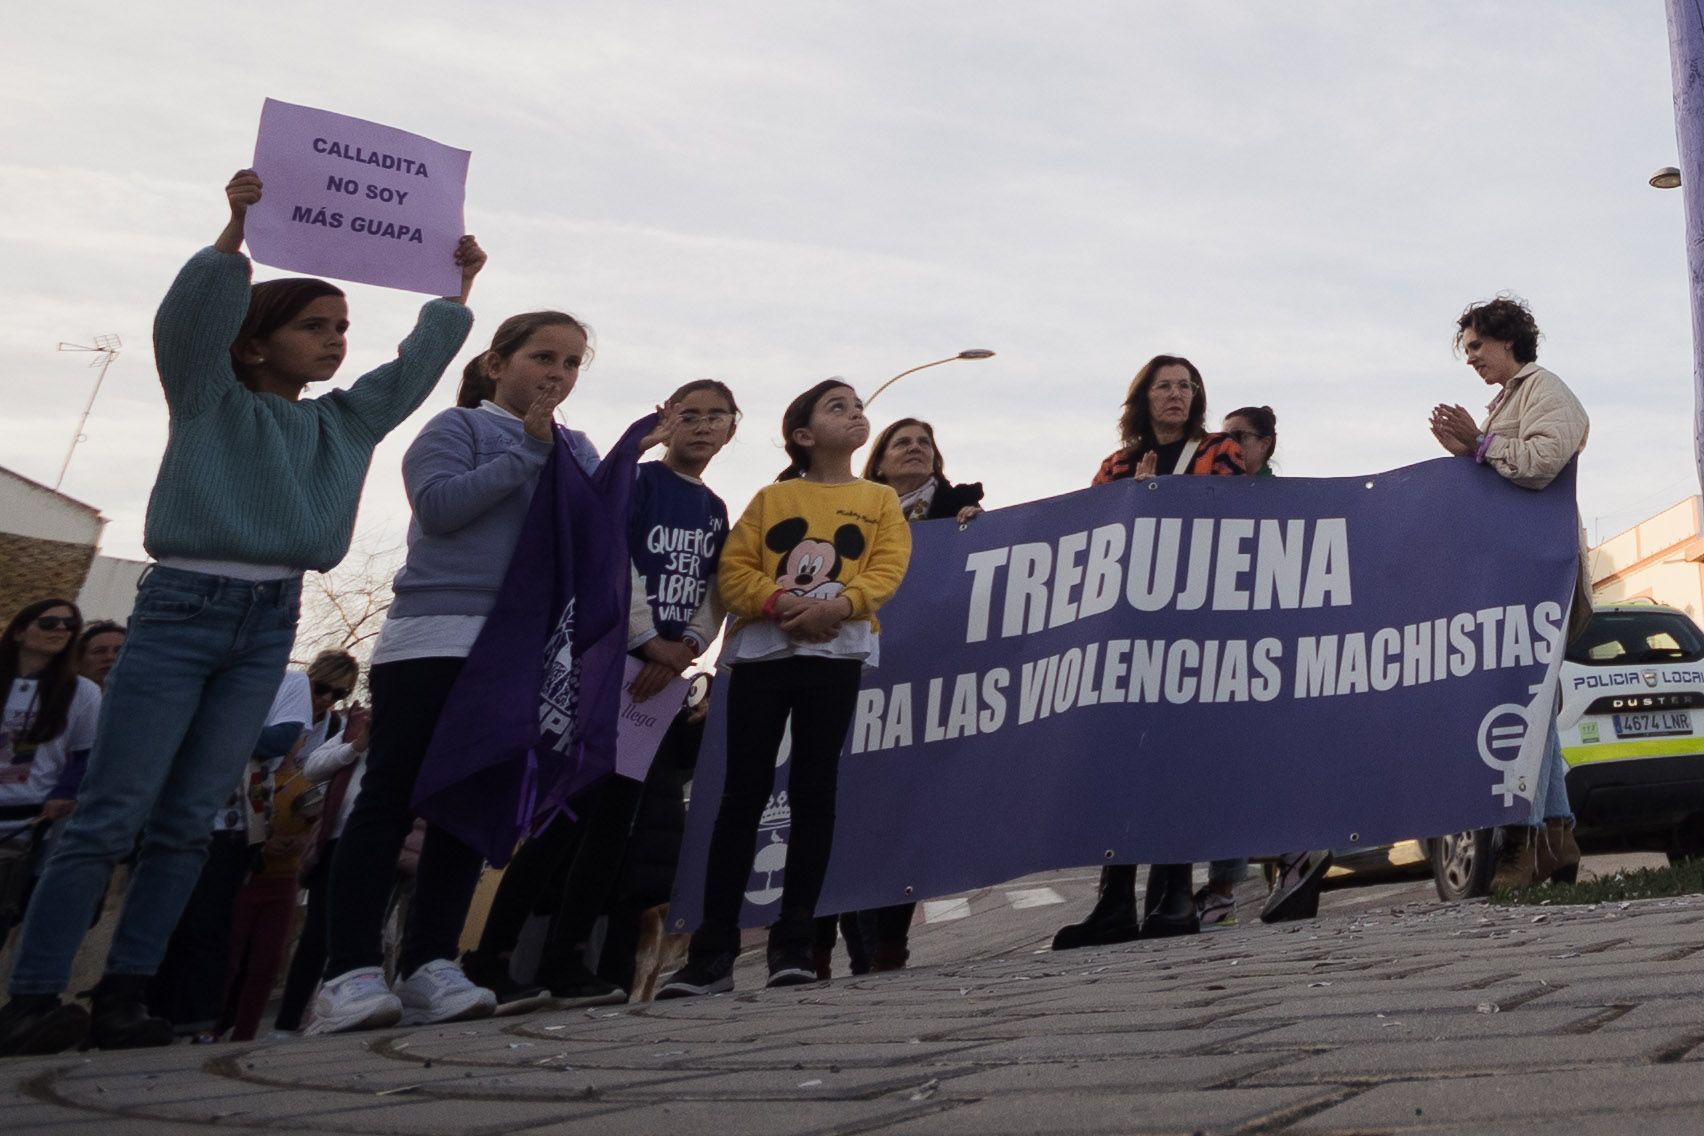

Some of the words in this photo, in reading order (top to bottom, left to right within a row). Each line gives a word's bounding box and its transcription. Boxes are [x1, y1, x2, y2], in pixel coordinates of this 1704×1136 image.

[312, 137, 429, 178] CALLADITA
[326, 175, 358, 195] NO
[365, 184, 408, 206] SOY
[292, 205, 343, 228] MÁS
[350, 216, 424, 244] GUAPA
[665, 552, 700, 577] SER
[964, 517, 1352, 643] TREBUJENA
[924, 667, 1010, 743] LAS
[1017, 637, 1283, 725] VIOLENCIAS
[1294, 601, 1562, 699] MACHISTAS
[1573, 672, 1640, 690] POLICIA
[1613, 696, 1692, 708] DUSTER
[1624, 716, 1660, 733] 4674
[1663, 715, 1689, 730] LNR
